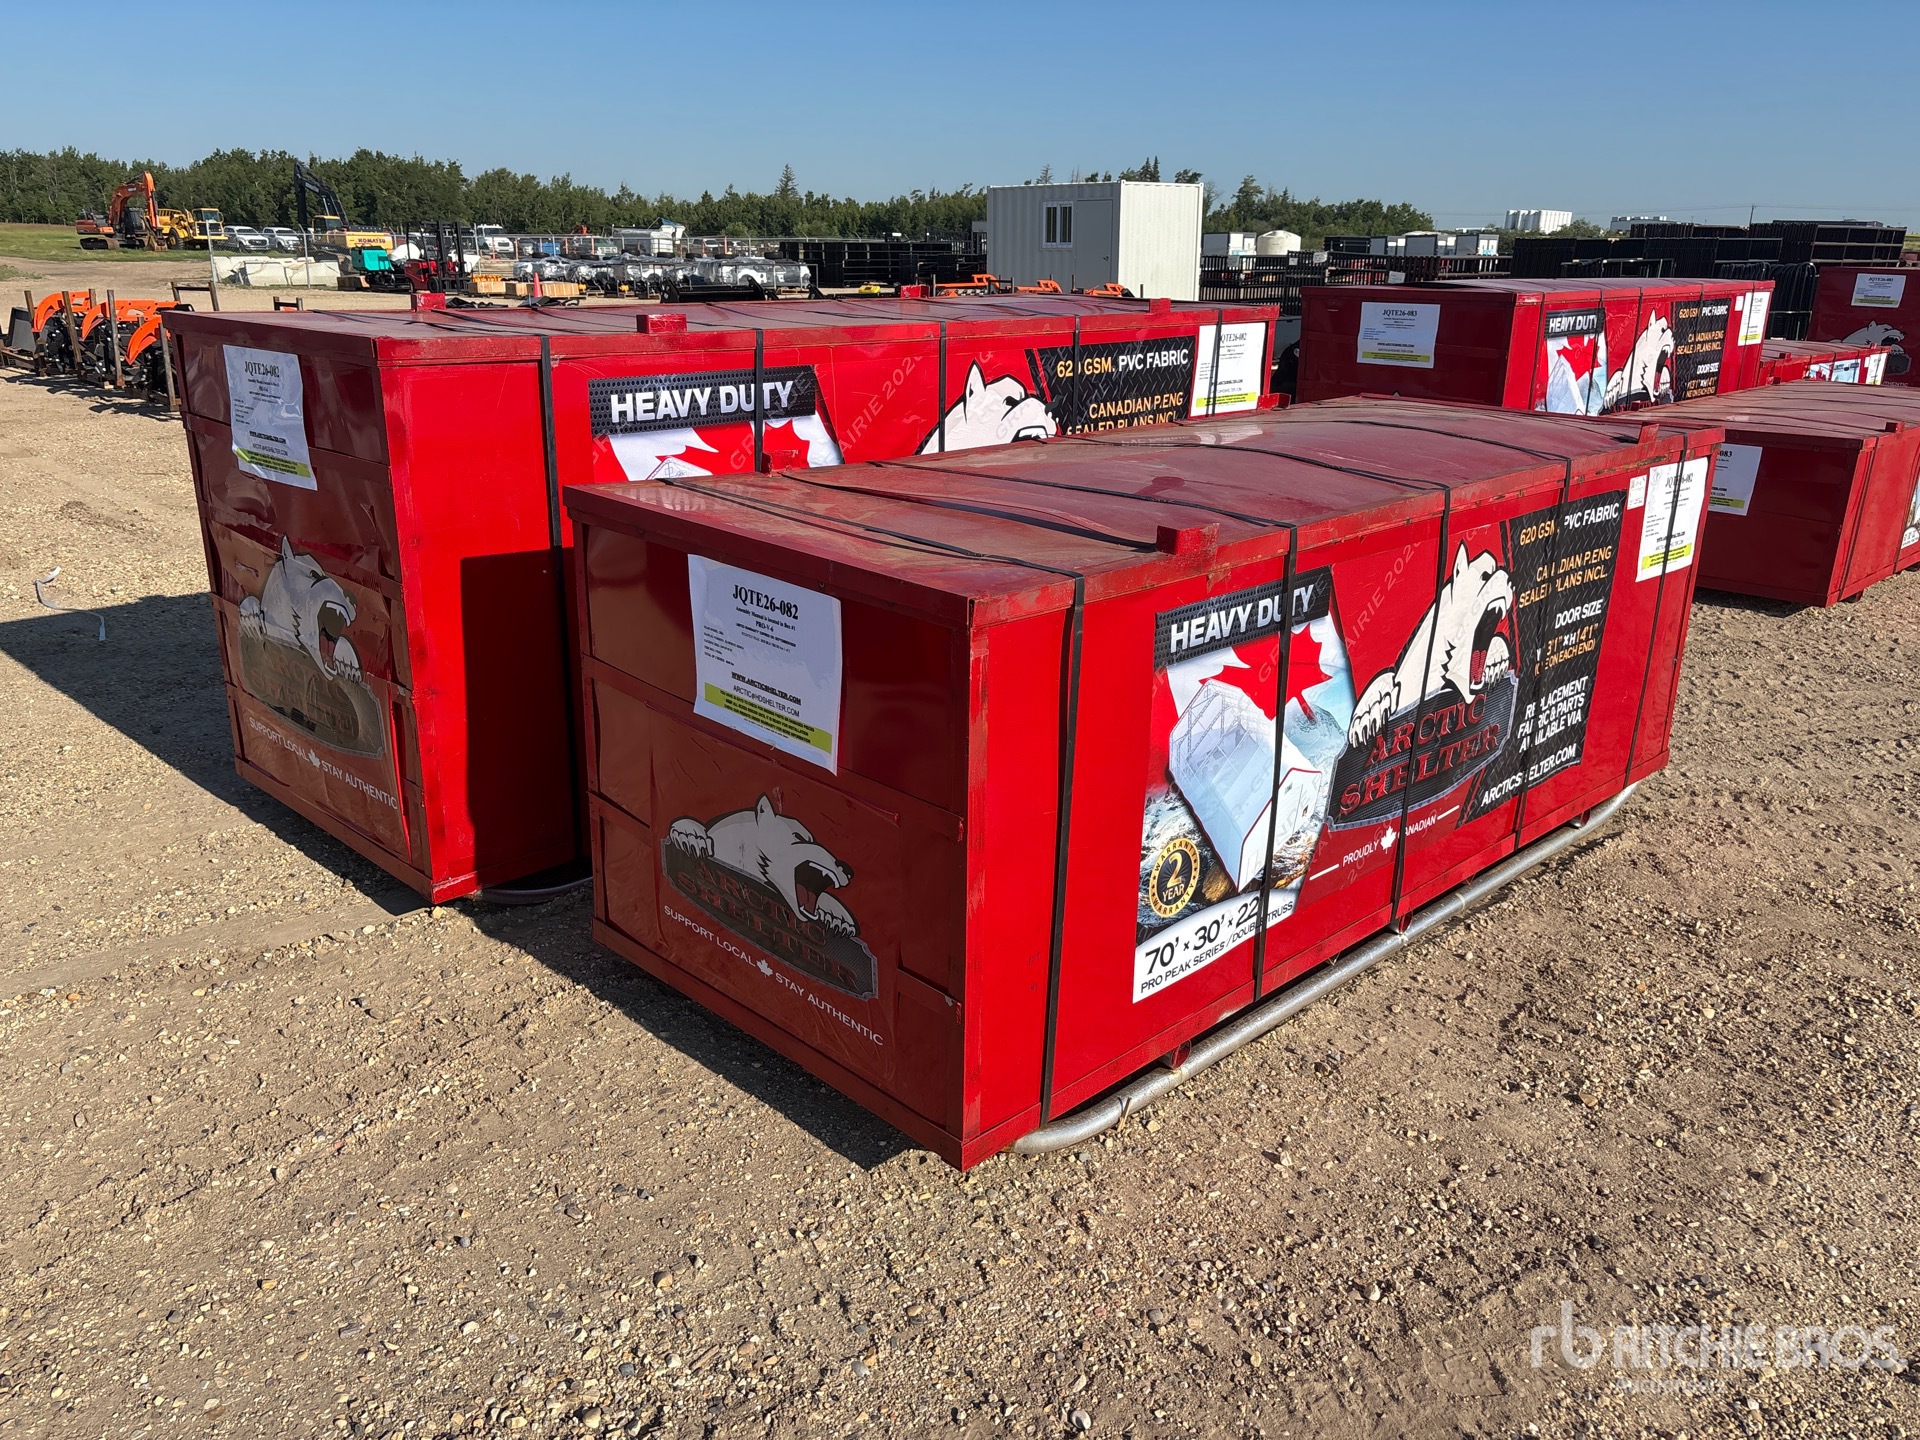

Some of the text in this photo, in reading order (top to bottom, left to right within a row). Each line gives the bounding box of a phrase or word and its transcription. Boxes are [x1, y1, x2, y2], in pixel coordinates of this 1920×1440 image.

[1383, 309, 1417, 317] JQTE26-083
[1549, 316, 1574, 333] HEAVY
[1712, 305, 1728, 315] FABRIC
[1084, 357, 1115, 376] GSM.
[1119, 354, 1144, 371] PVC
[1146, 349, 1188, 368] FABRIC
[611, 387, 713, 423] HEAVY
[1089, 395, 1152, 420] CANADIAN
[1154, 392, 1184, 410] P.ENG
[1520, 530, 1536, 546] 620
[1583, 503, 1619, 526] FABRIC
[1384, 542, 1422, 591] 202
[1583, 546, 1612, 564] P.ENG
[1584, 565, 1608, 582] INCL.
[732, 584, 799, 620] JQTE26-082
[1555, 599, 1604, 629] DOOR SIZE
[1170, 603, 1253, 653] HEAVY
[1558, 648, 1578, 664] EACH
[731, 672, 802, 706] WWW.ARCTICSHELTER.COM
[733, 684, 800, 718] ARCTIC@HDSHELTER.COM
[1550, 709, 1557, 719] &
[1556, 693, 1585, 715] PARTS
[1366, 692, 1487, 768] ARCTIC
[1568, 710, 1581, 726] VIA
[249, 716, 309, 762] SUPPORT LOCAL
[321, 760, 398, 809] STAY AUTHENTIC
[1339, 723, 1500, 816] SHELTER
[1155, 841, 1197, 872] WARRANTY
[1342, 816, 1436, 867] PROUDLY ANADIAN
[1168, 852, 1182, 888] 2
[1152, 883, 1194, 915] WARRANTY
[1162, 884, 1185, 902] YEAR
[663, 905, 756, 968] SUPPORT LOCAL
[1140, 975, 1163, 994] PRO
[1164, 961, 1192, 983] PEAK
[1192, 940, 1225, 966] SERIES
[1267, 901, 1293, 923] TRUSS
[1145, 936, 1180, 975] 70'
[1193, 914, 1226, 952] 30'
[775, 973, 884, 1046] STAY AUTHENTIC
